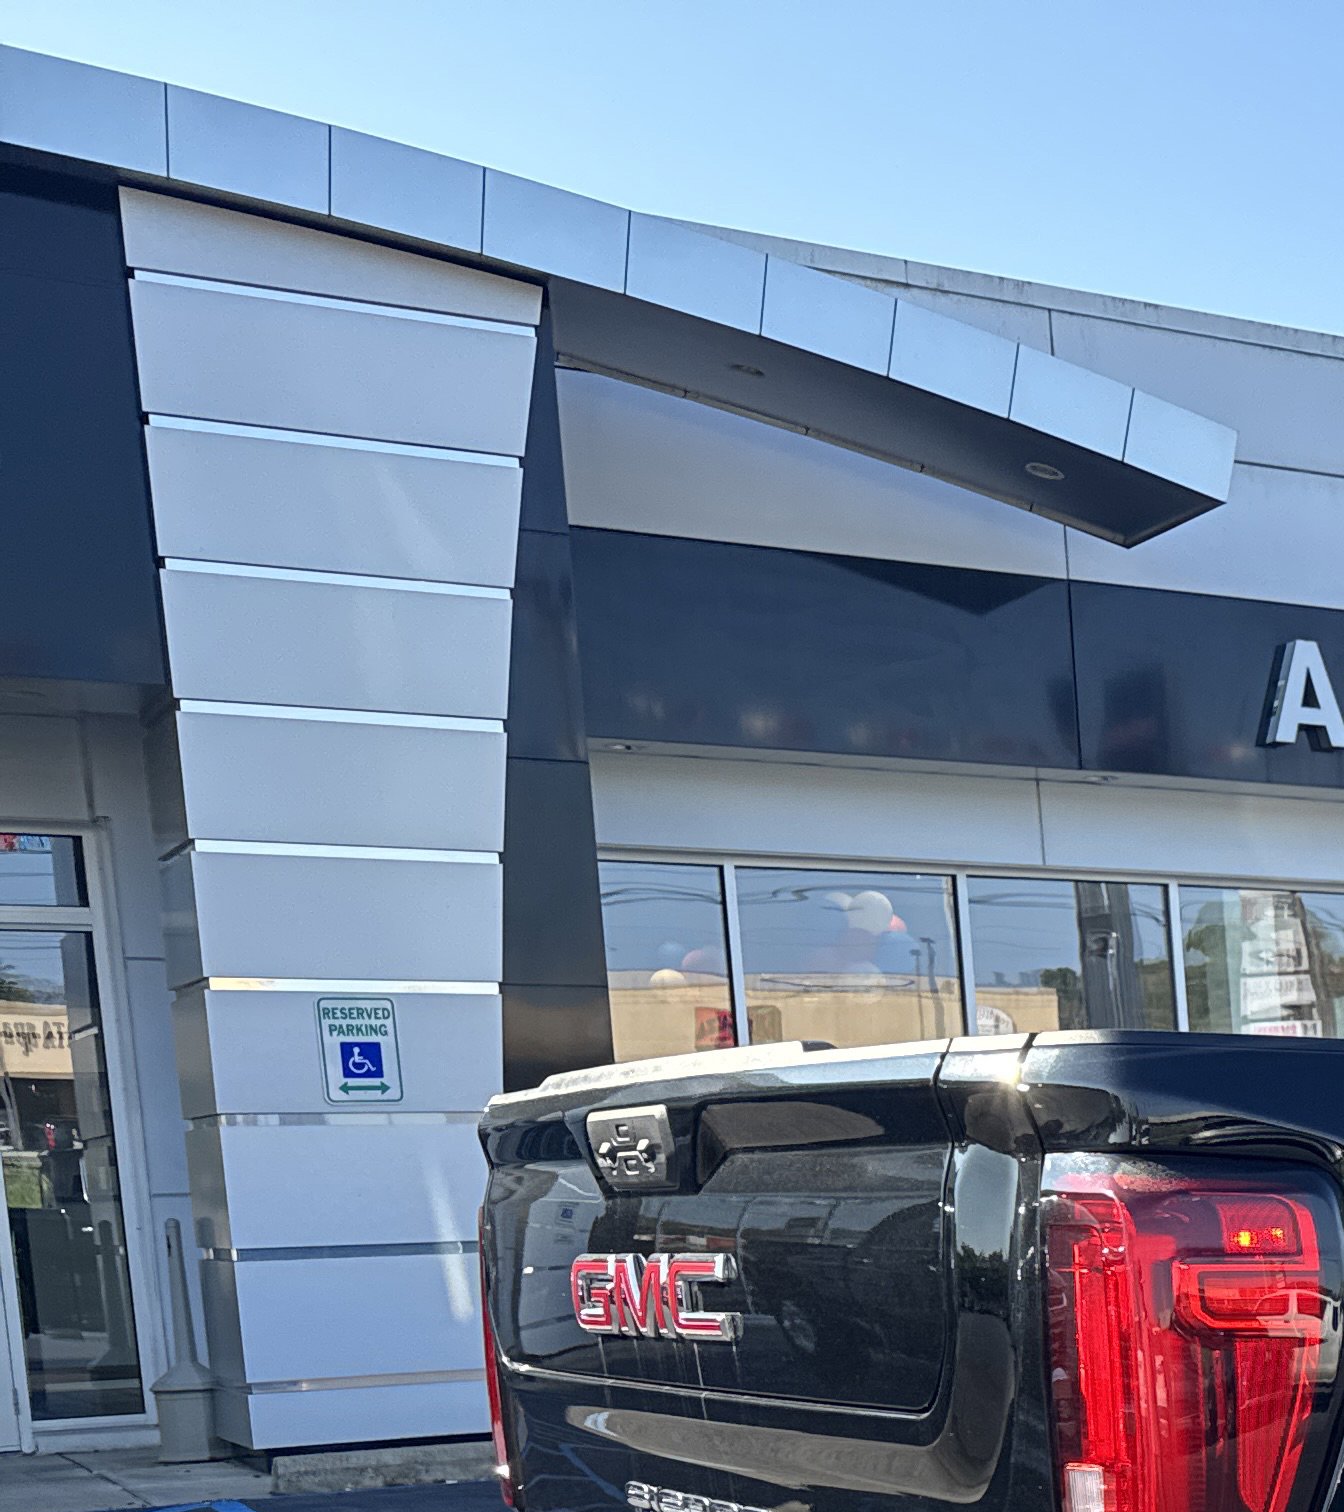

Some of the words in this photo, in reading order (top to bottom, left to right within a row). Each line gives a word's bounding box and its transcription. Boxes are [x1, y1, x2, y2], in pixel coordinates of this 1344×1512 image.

[322, 1007, 391, 1020] RESERVED
[328, 1024, 388, 1037] PARKING
[570, 1252, 743, 1343] GMC
